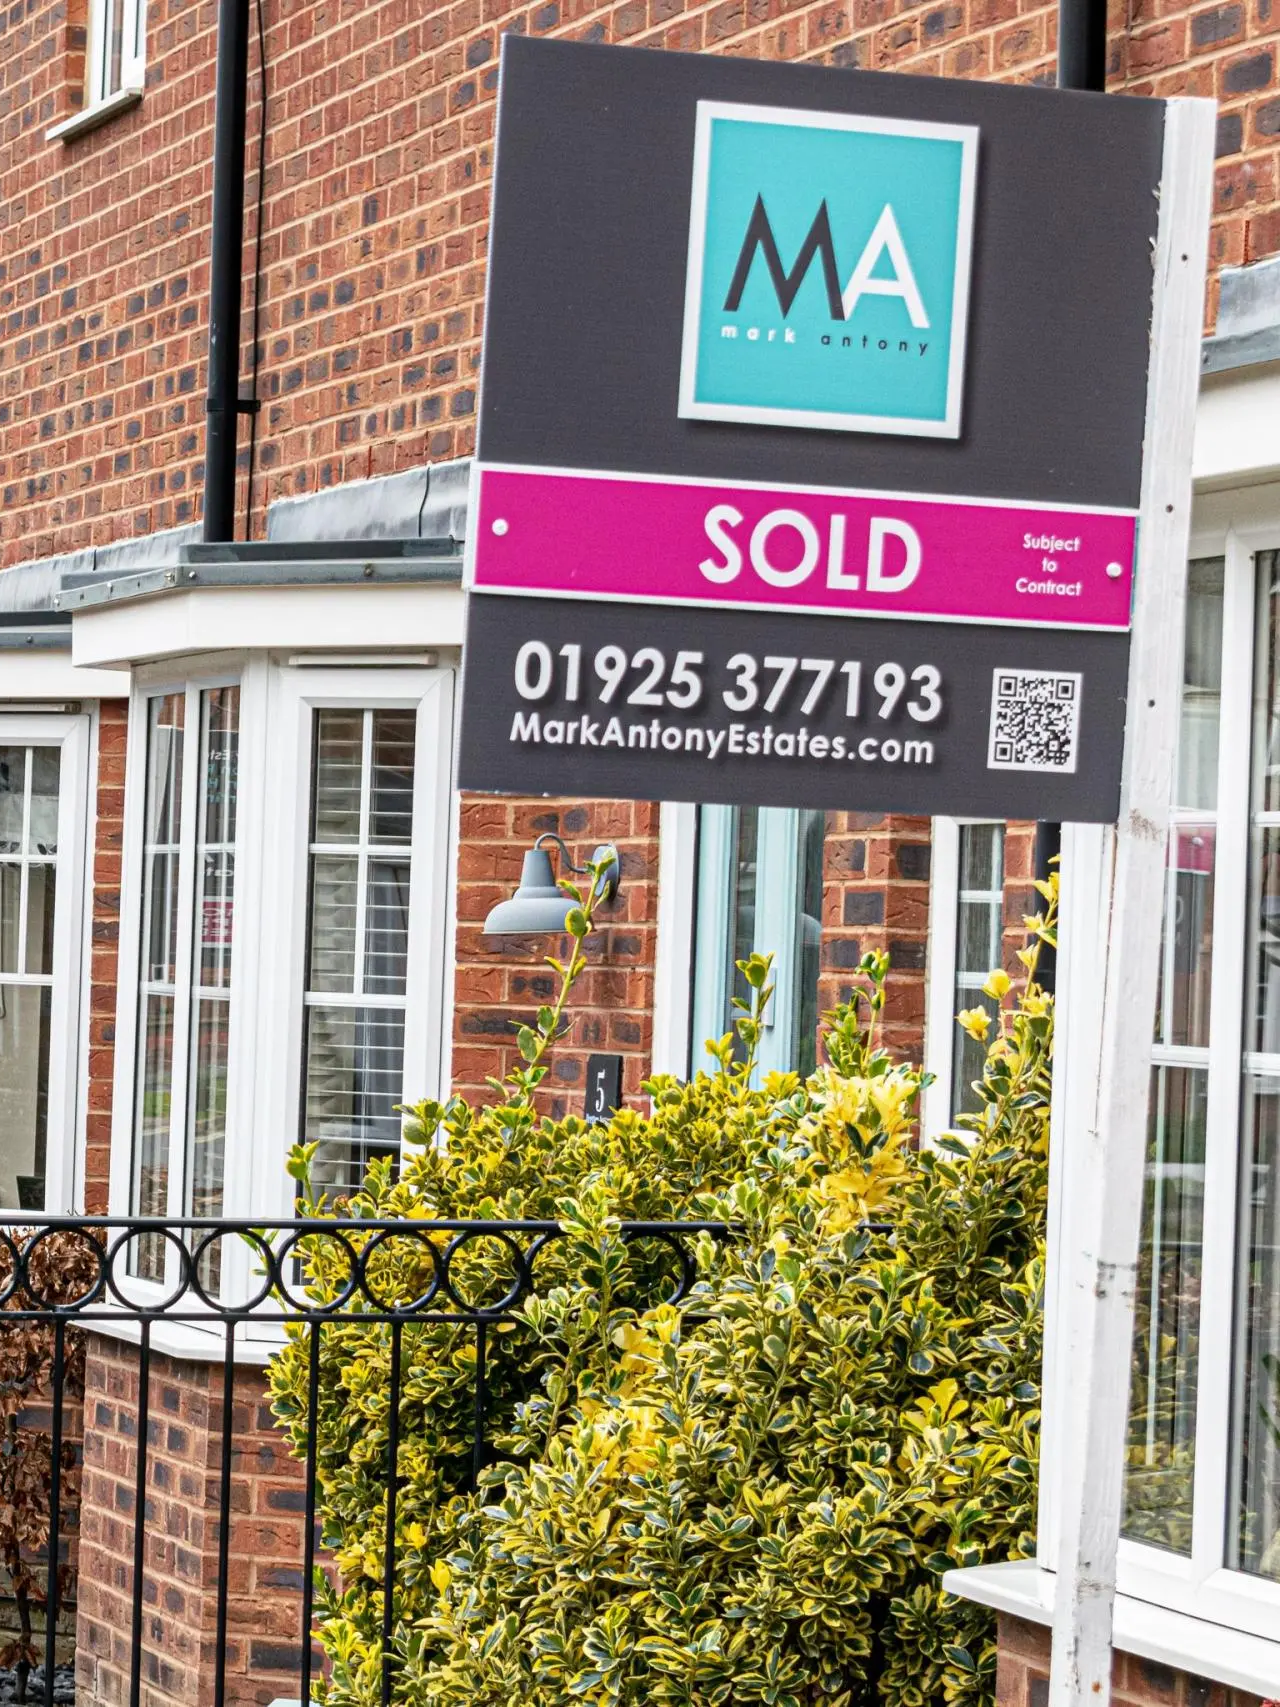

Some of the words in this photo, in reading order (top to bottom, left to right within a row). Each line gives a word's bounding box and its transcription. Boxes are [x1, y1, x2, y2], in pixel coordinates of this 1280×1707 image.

[723, 191, 929, 329] MA
[721, 324, 795, 344] mark
[821, 333, 929, 356] antony
[699, 504, 920, 593] SOLD
[1022, 532, 1081, 554] Subject
[1041, 557, 1058, 573] to
[1015, 577, 1082, 597] Contract
[514, 640, 704, 709] 01925
[722, 653, 943, 722] 377193
[509, 710, 934, 764] MarkAntonyEstates.com
[596, 1069, 606, 1113] 5
